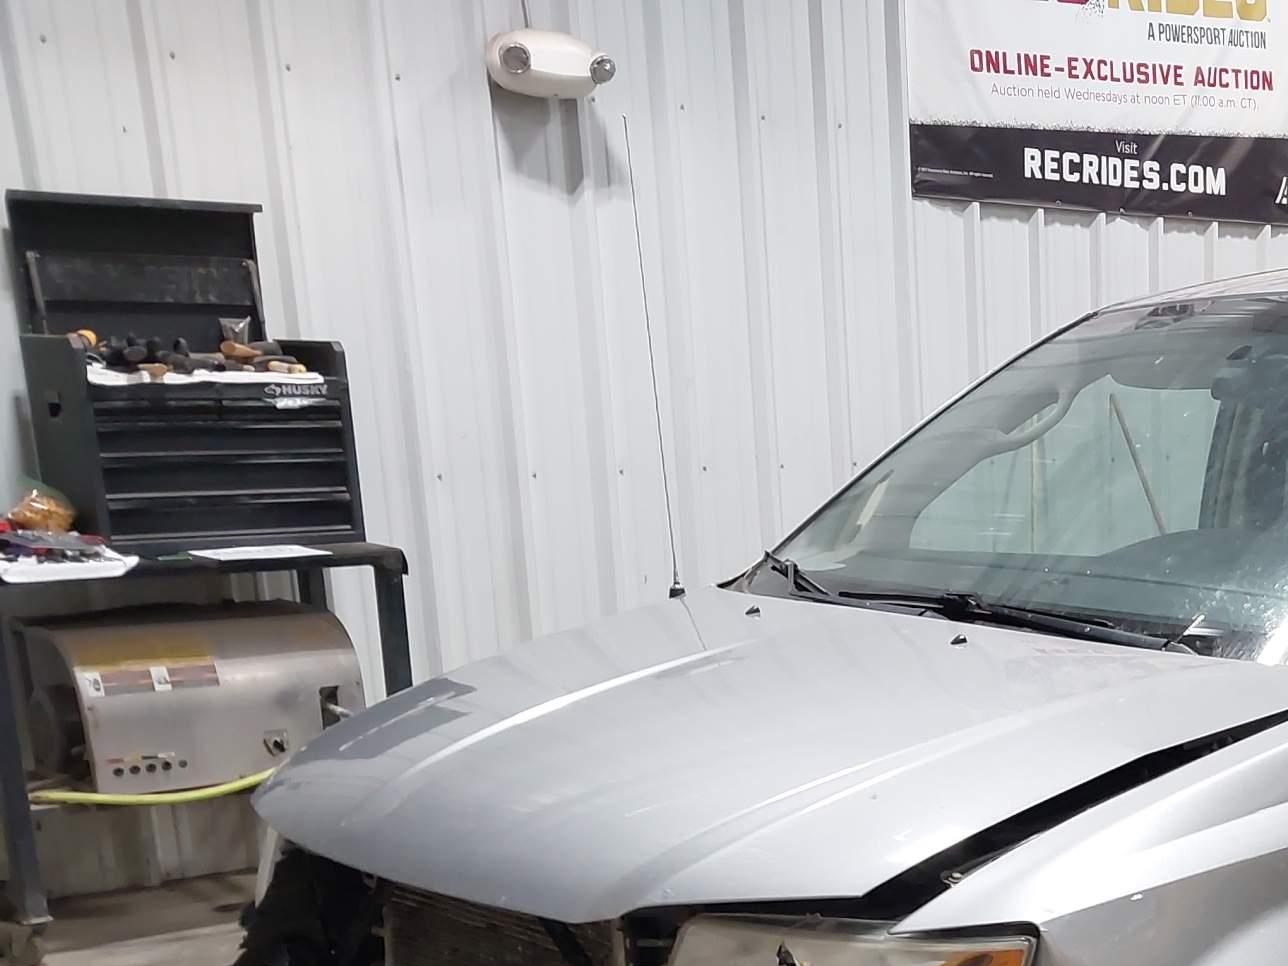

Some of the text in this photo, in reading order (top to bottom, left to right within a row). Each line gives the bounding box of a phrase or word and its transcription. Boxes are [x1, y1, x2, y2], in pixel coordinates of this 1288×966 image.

[1147, 22, 1267, 49] A POWERSPORT AUCTION
[969, 49, 1274, 91] ONLINE-EXCLUSIVE AUCTION
[991, 83, 1034, 97] Auction
[1037, 86, 1061, 100] held
[1064, 88, 1128, 105] Wednesdays
[1130, 93, 1141, 104] at
[1144, 94, 1170, 106] noon
[1173, 94, 1187, 106] ET
[1115, 140, 1138, 154] Visit
[1023, 147, 1227, 196] RECRIDES.COM
[282, 384, 328, 395] HUSKY
